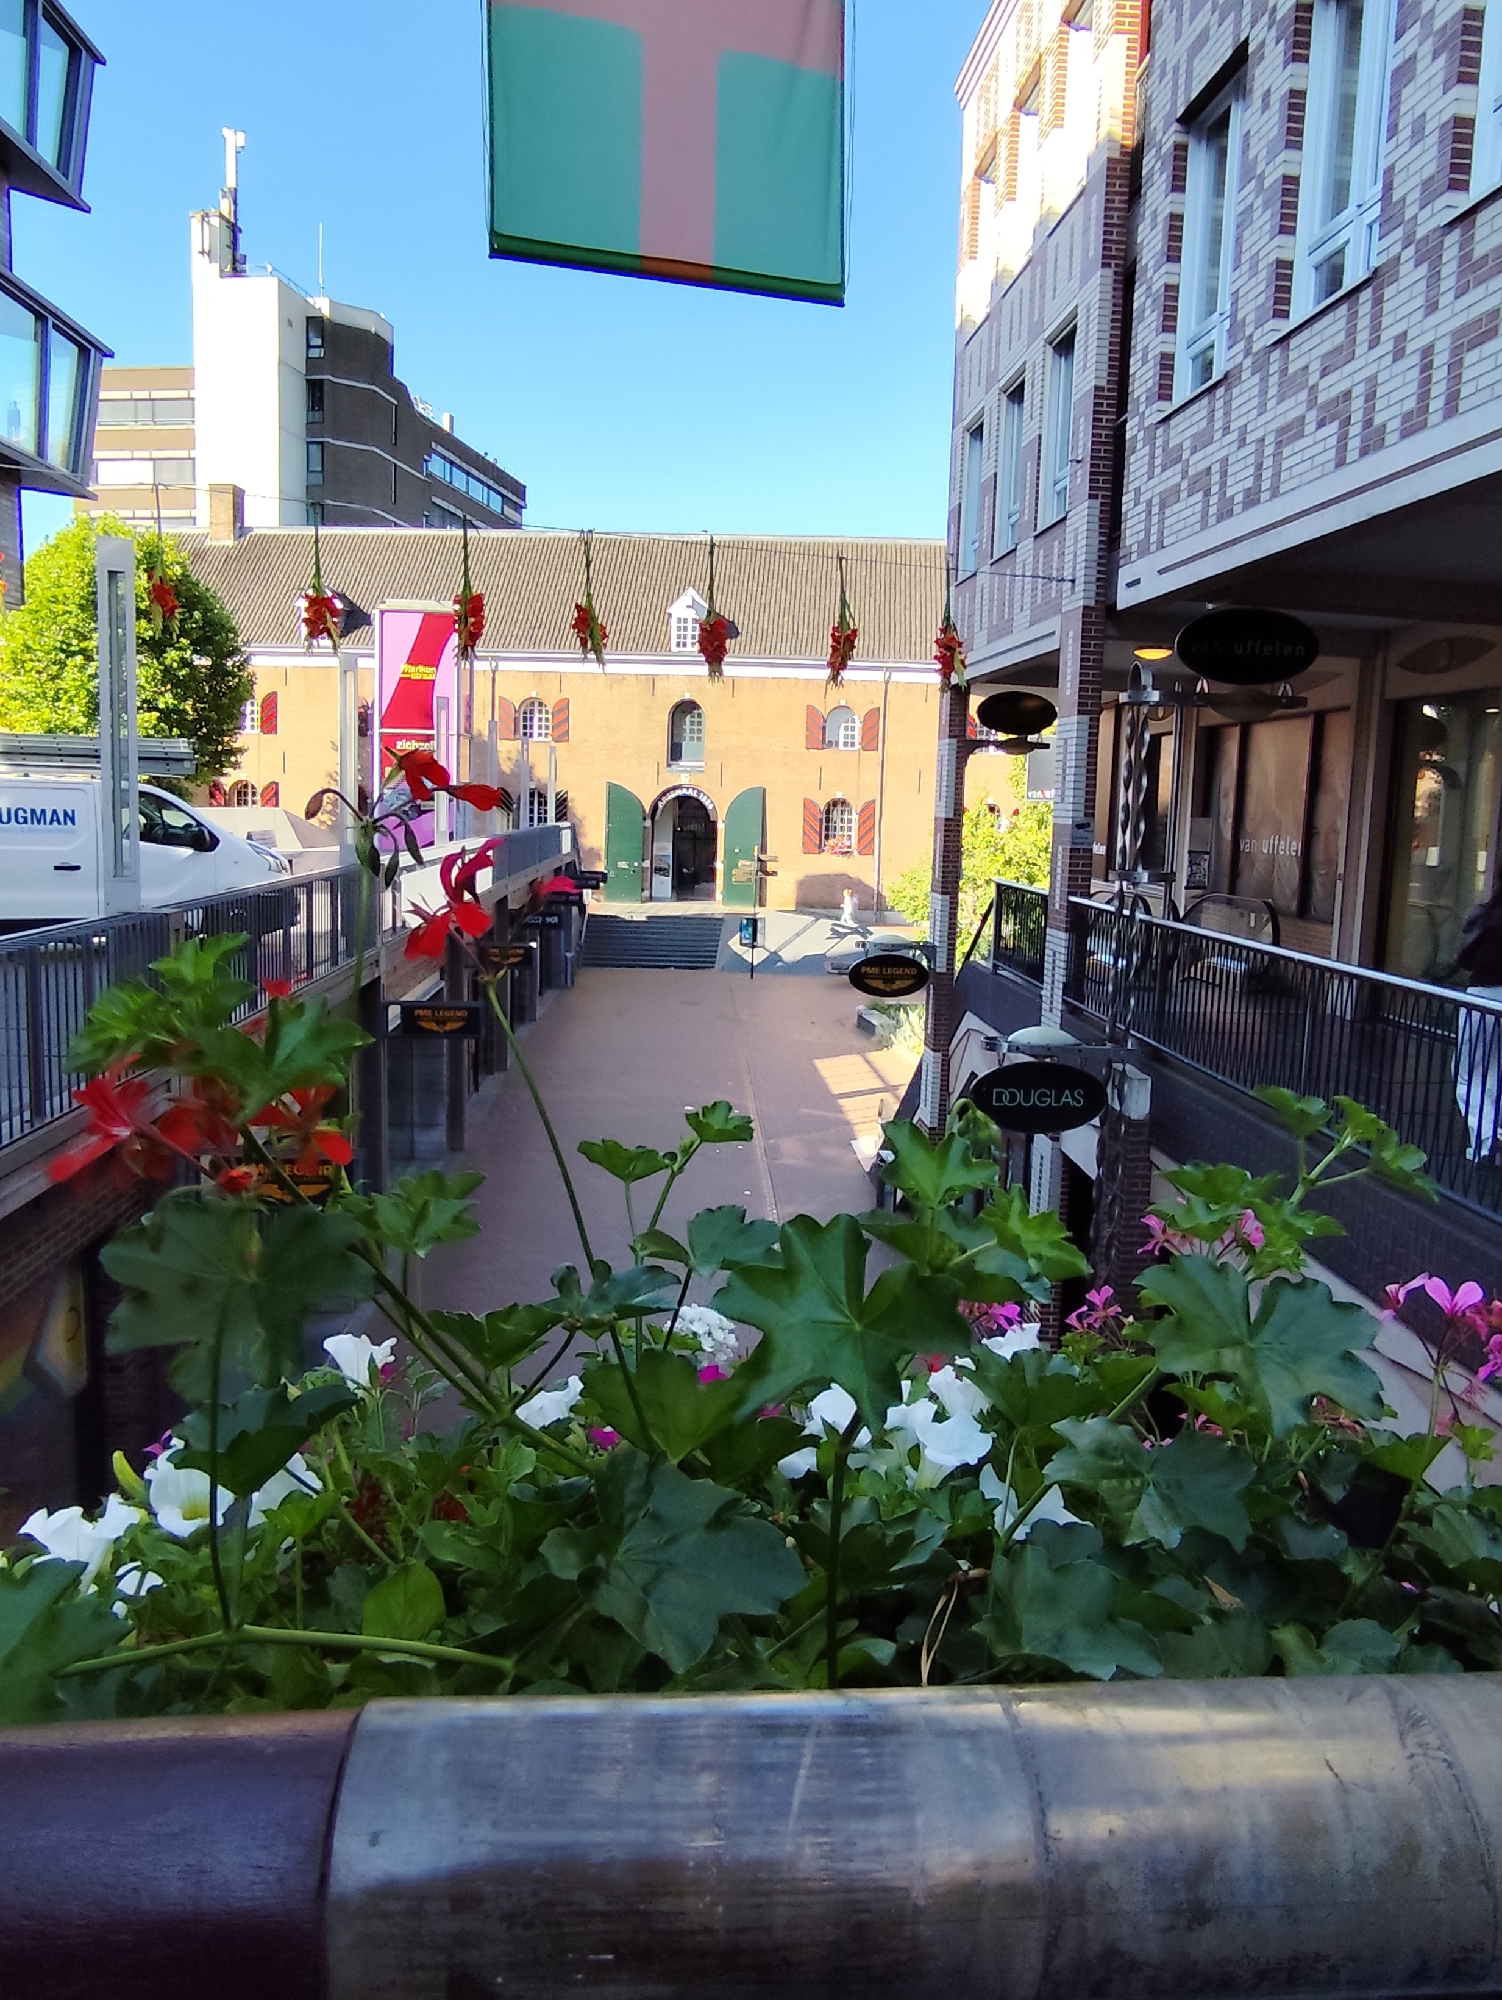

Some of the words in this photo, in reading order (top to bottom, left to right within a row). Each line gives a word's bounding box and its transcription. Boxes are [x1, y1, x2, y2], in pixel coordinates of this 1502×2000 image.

[1233, 640, 1305, 656] uffelen
[1240, 838, 1257, 853] van
[861, 966, 880, 974] PME
[882, 967, 918, 975] LEGEND
[414, 1009, 432, 1017] PME
[434, 1009, 468, 1017] LEGEND
[992, 1088, 1084, 1107] DOUGLAS
